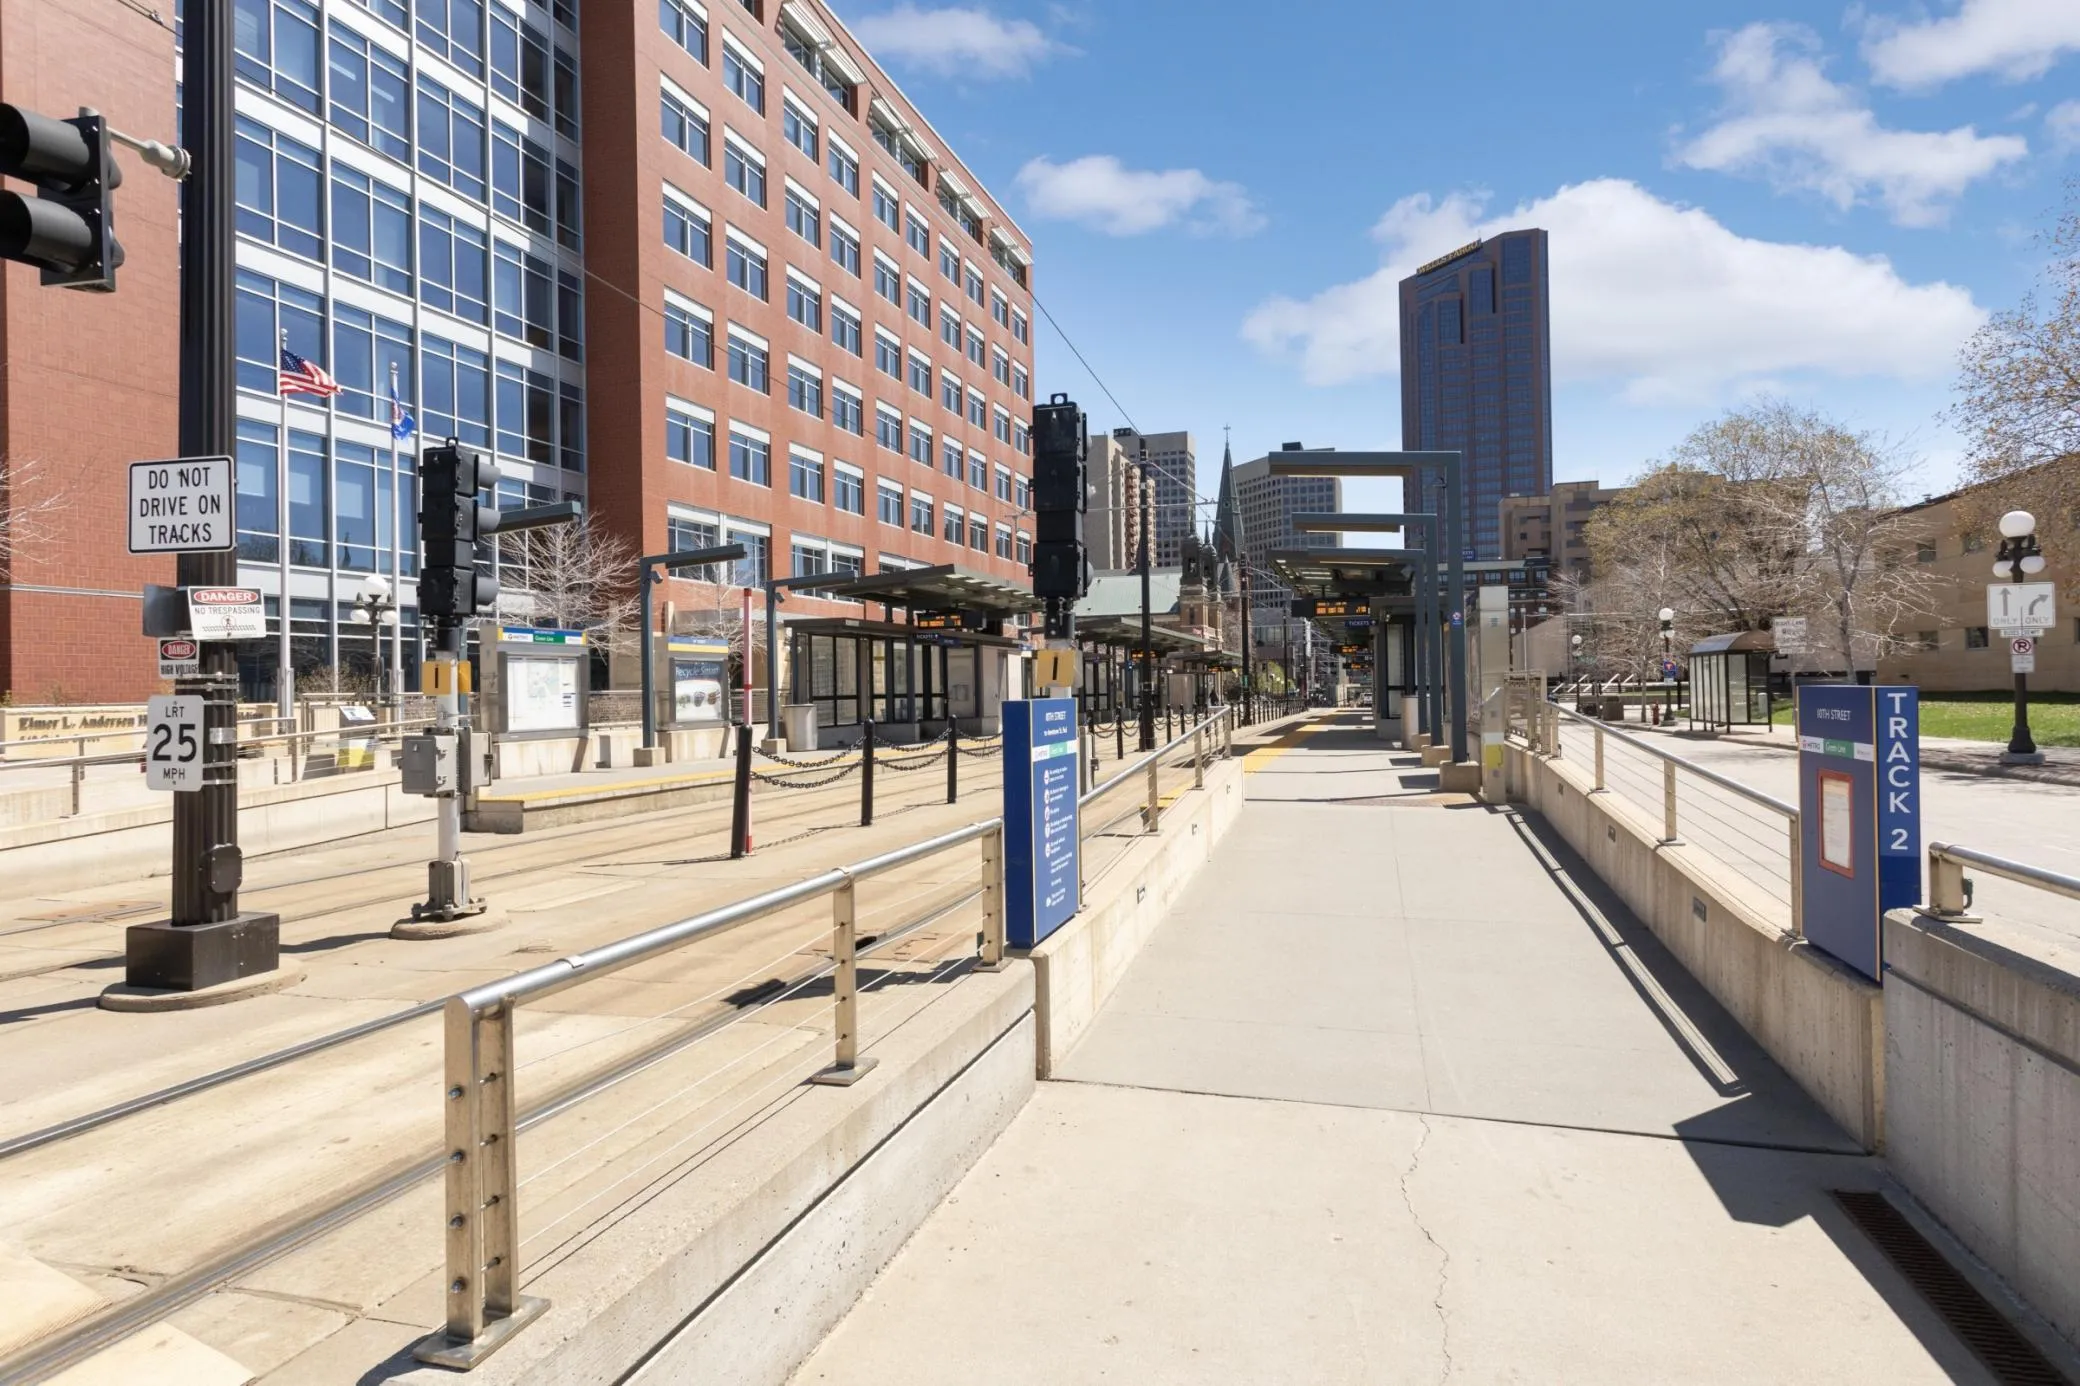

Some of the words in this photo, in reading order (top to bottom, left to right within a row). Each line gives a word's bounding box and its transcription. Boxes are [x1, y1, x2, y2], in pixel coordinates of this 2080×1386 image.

[148, 469, 169, 489] DO
[179, 466, 211, 488] NOT
[140, 496, 188, 517] DRIVE
[198, 494, 221, 515] ON
[148, 522, 212, 545] TRACKS
[201, 591, 252, 601] DANGER
[194, 607, 205, 615] NO
[209, 606, 261, 614] TRESPASSING
[1993, 617, 2018, 626] ONLY
[2024, 615, 2050, 625] ONLY
[168, 644, 191, 655] DANGER
[160, 664, 174, 675] HIGH
[165, 706, 185, 718] LRT
[1816, 708, 1830, 719] 10TH
[1830, 709, 1852, 721] STREET
[18, 717, 60, 731] Elmer
[78, 714, 135, 729] Andersen
[152, 723, 197, 763] 25
[1886, 692, 1911, 813] TRACK
[163, 767, 186, 780] MPH
[1890, 828, 1909, 850] 2
